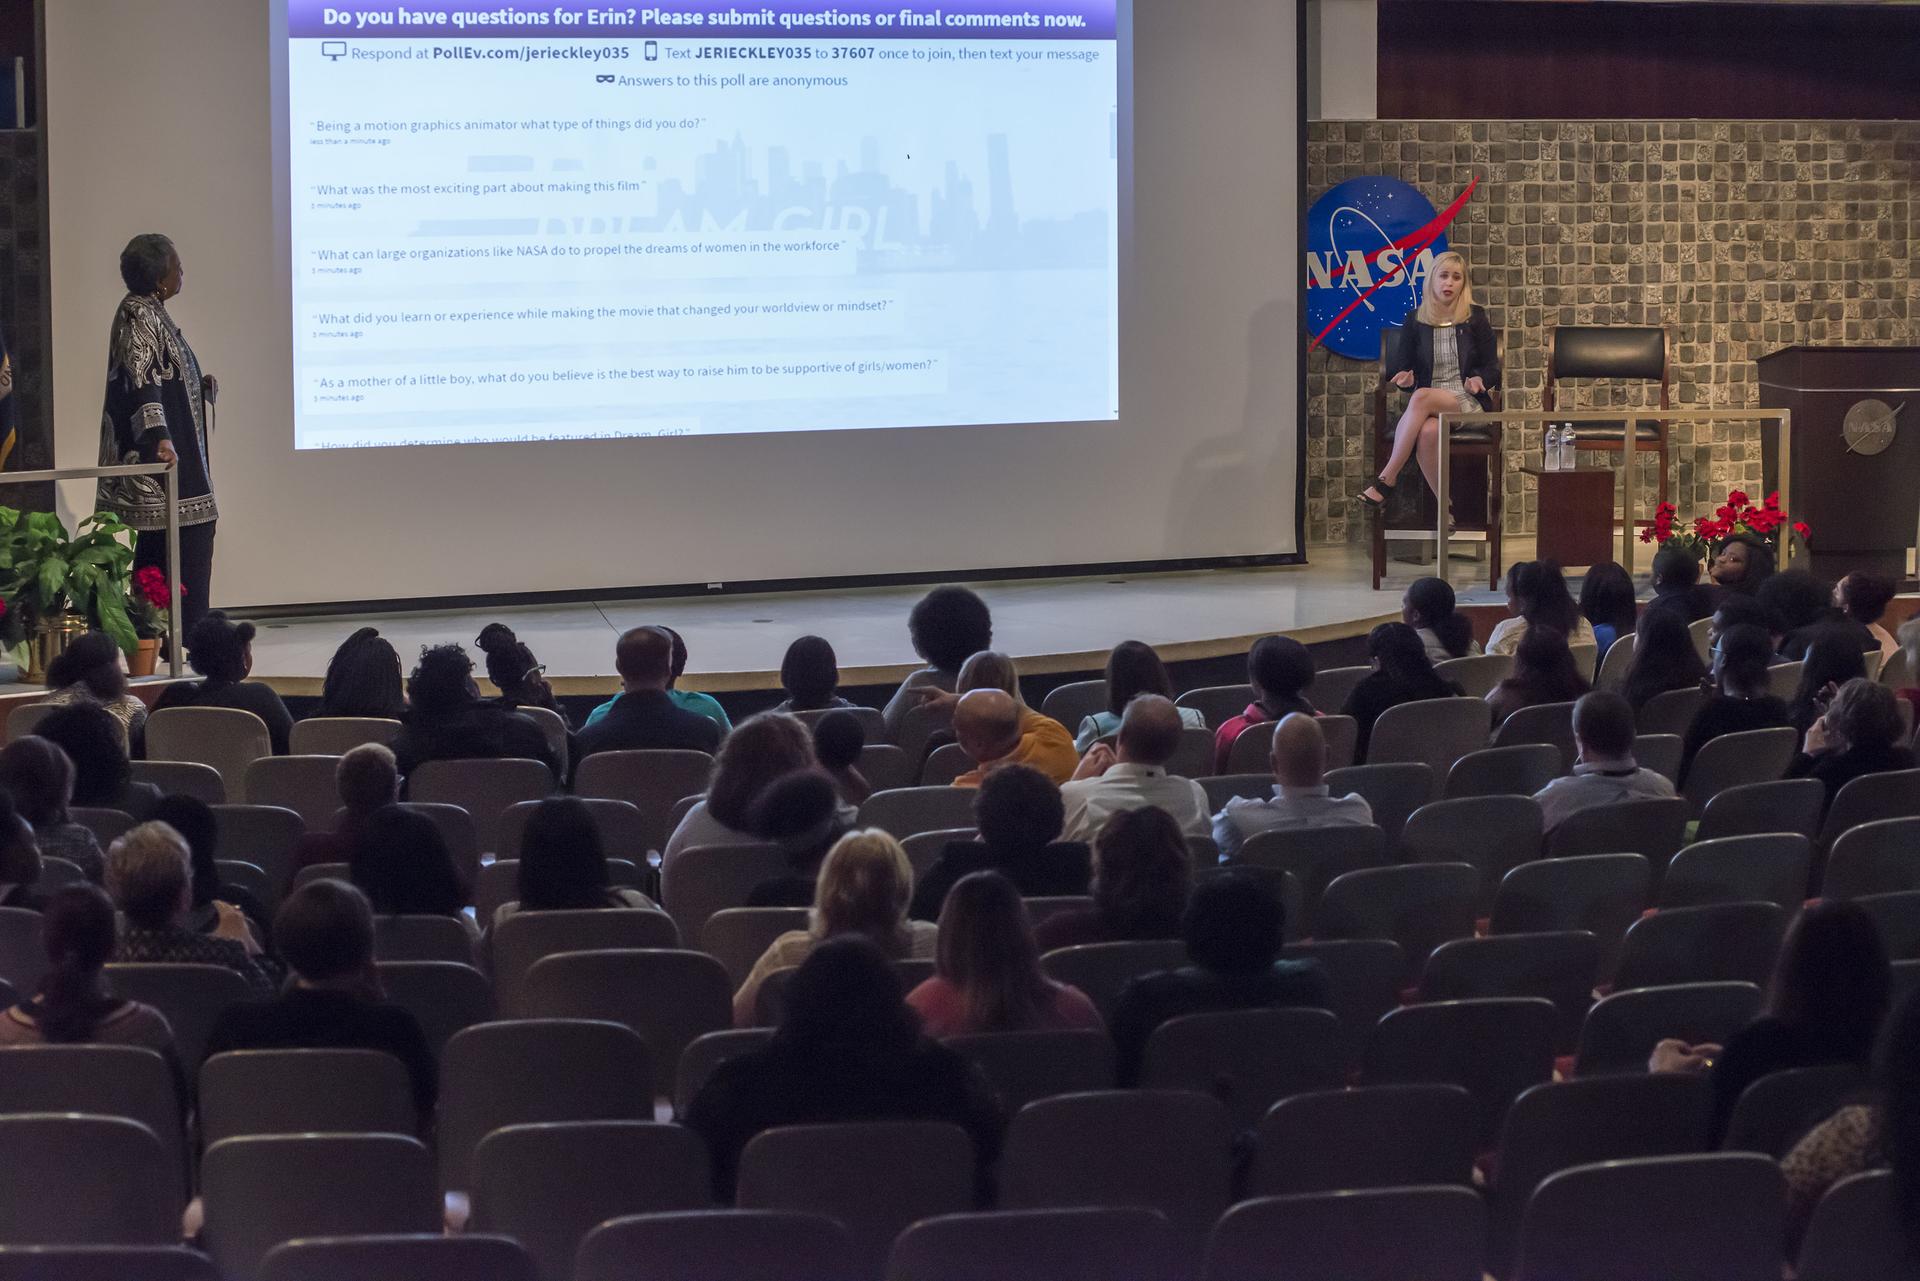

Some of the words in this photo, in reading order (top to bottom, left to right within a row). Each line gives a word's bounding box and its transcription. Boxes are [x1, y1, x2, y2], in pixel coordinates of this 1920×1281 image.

[322, 8, 350, 25] Do
[356, 13, 394, 30] you
[398, 8, 447, 26] have
[451, 8, 550, 30] questions
[553, 9, 583, 26] for
[587, 9, 636, 26] Erin?
[641, 9, 704, 26] Please
[708, 9, 776, 26] submit
[779, 9, 872, 31] questions
[875, 14, 896, 27] or
[899, 9, 942, 27] final
[945, 11, 1040, 27] comments
[1045, 14, 1086, 27] now.
[352, 47, 411, 63] Respond
[416, 48, 429, 60] at
[433, 47, 630, 63] PollEv.com/jerieckley035
[665, 47, 691, 60] Text
[694, 47, 812, 60] JERIECKLEY035
[815, 48, 829, 60] to
[831, 47, 875, 60] 37607
[878, 50, 909, 60] once
[912, 48, 926, 60] to
[927, 47, 956, 63] join,
[958, 47, 987, 60] then
[989, 48, 1013, 60] text
[1015, 50, 1043, 63] your
[1046, 50, 1100, 63] message
[618, 74, 672, 87] Answers
[676, 75, 690, 87] to
[693, 74, 717, 87] this
[720, 74, 745, 90] poll
[749, 77, 769, 87] are
[772, 77, 848, 90] anonymous
[354, 122, 361, 131] a
[364, 119, 407, 131] motion
[410, 119, 461, 134] graphics
[464, 118, 517, 130] animator
[520, 118, 550, 130] what
[552, 119, 579, 133] type
[581, 118, 593, 129] of
[595, 117, 632, 132] things
[634, 117, 653, 129] did
[655, 120, 677, 132] you
[351, 186, 375, 195] was
[378, 183, 398, 195] the
[400, 184, 430, 194] most
[433, 182, 480, 197] exciting
[483, 183, 506, 196] part
[510, 181, 544, 193] about
[547, 181, 591, 196] making
[593, 180, 615, 192] this
[352, 250, 373, 260] can
[377, 247, 405, 262] large
[410, 246, 490, 262] organizations
[493, 245, 513, 257] like
[517, 245, 548, 257] NASA
[550, 244, 566, 256] do
[568, 246, 581, 256] to
[584, 243, 621, 259] propel
[624, 243, 642, 255] the
[646, 242, 687, 255] dreams
[691, 242, 702, 254] of
[705, 244, 746, 254] women
[750, 241, 760, 253] in
[763, 241, 781, 253] the
[348, 268, 363, 276] ago
[1306, 248, 1435, 289] NASA
[353, 311, 373, 323] did
[375, 314, 398, 326] you
[401, 310, 431, 322] learn
[434, 312, 446, 322] or
[449, 308, 514, 324] experience
[516, 307, 548, 320] while
[551, 306, 595, 322] making
[597, 306, 616, 318] the
[619, 305, 654, 317] movie
[656, 305, 680, 317] that
[682, 303, 731, 319] changed
[734, 305, 759, 318] your
[761, 301, 820, 314] worldview
[822, 304, 833, 313] or
[337, 378, 345, 388] a
[349, 374, 390, 387] mother
[394, 374, 407, 386] of
[409, 376, 417, 385] a
[419, 373, 447, 385] little
[449, 372, 475, 387] boy,
[477, 371, 507, 383] what
[509, 370, 525, 382] do
[528, 372, 549, 385] you
[552, 368, 594, 381] believe
[597, 368, 606, 380] is
[608, 367, 628, 380] the
[630, 367, 654, 379] best
[657, 368, 680, 381] way
[683, 367, 695, 377] to
[697, 364, 724, 377] raise
[726, 364, 749, 376] him
[751, 365, 763, 375] to
[765, 363, 780, 375] be
[782, 361, 842, 377] supportive
[844, 361, 856, 372] of
[1848, 421, 1893, 433] NASA
